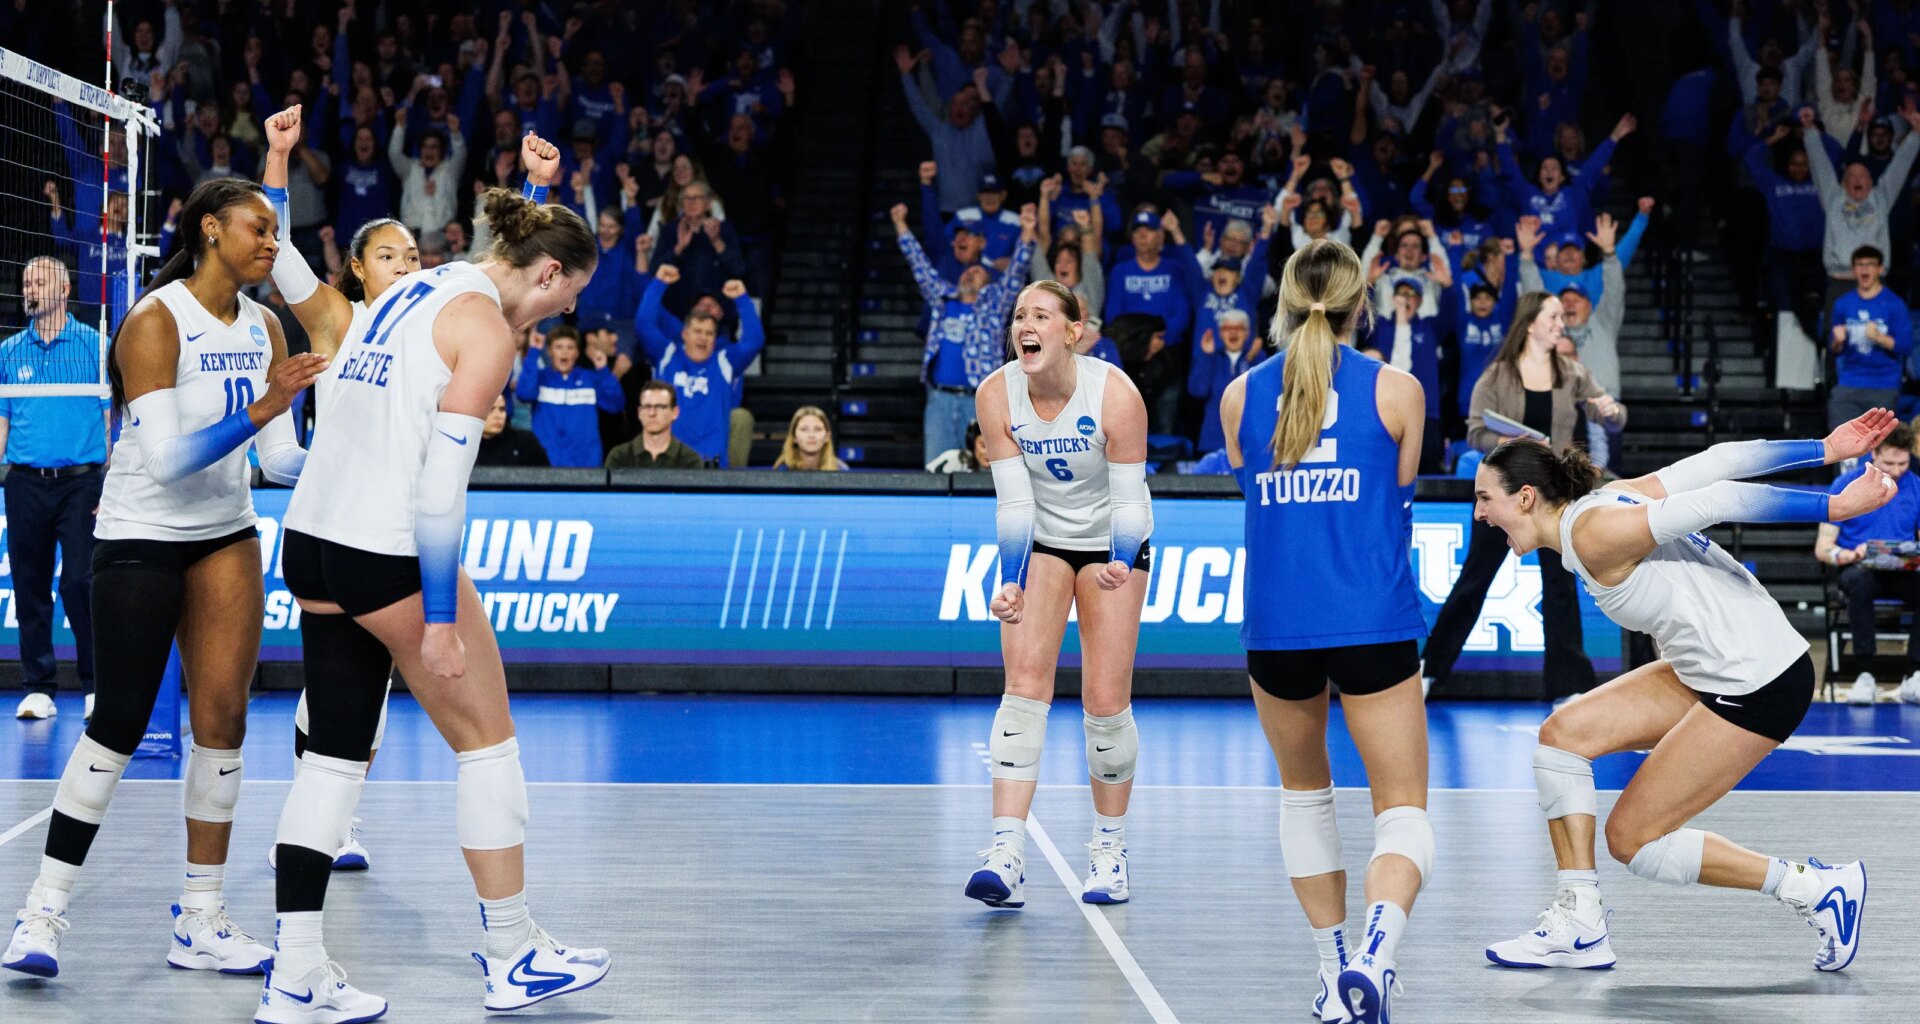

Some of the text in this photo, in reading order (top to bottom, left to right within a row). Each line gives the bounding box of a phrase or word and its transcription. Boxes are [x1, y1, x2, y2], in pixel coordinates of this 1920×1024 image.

[362, 281, 436, 345] 17
[200, 352, 263, 371] KENTUCKY
[223, 377, 255, 420] 10
[1019, 437, 1091, 455] KENTUCKY
[1079, 424, 1096, 432] NCAA
[1045, 457, 1074, 482] 6
[1255, 468, 1361, 506] TUOZZO
[460, 519, 594, 581] UND
[477, 591, 620, 633] TUCKY
